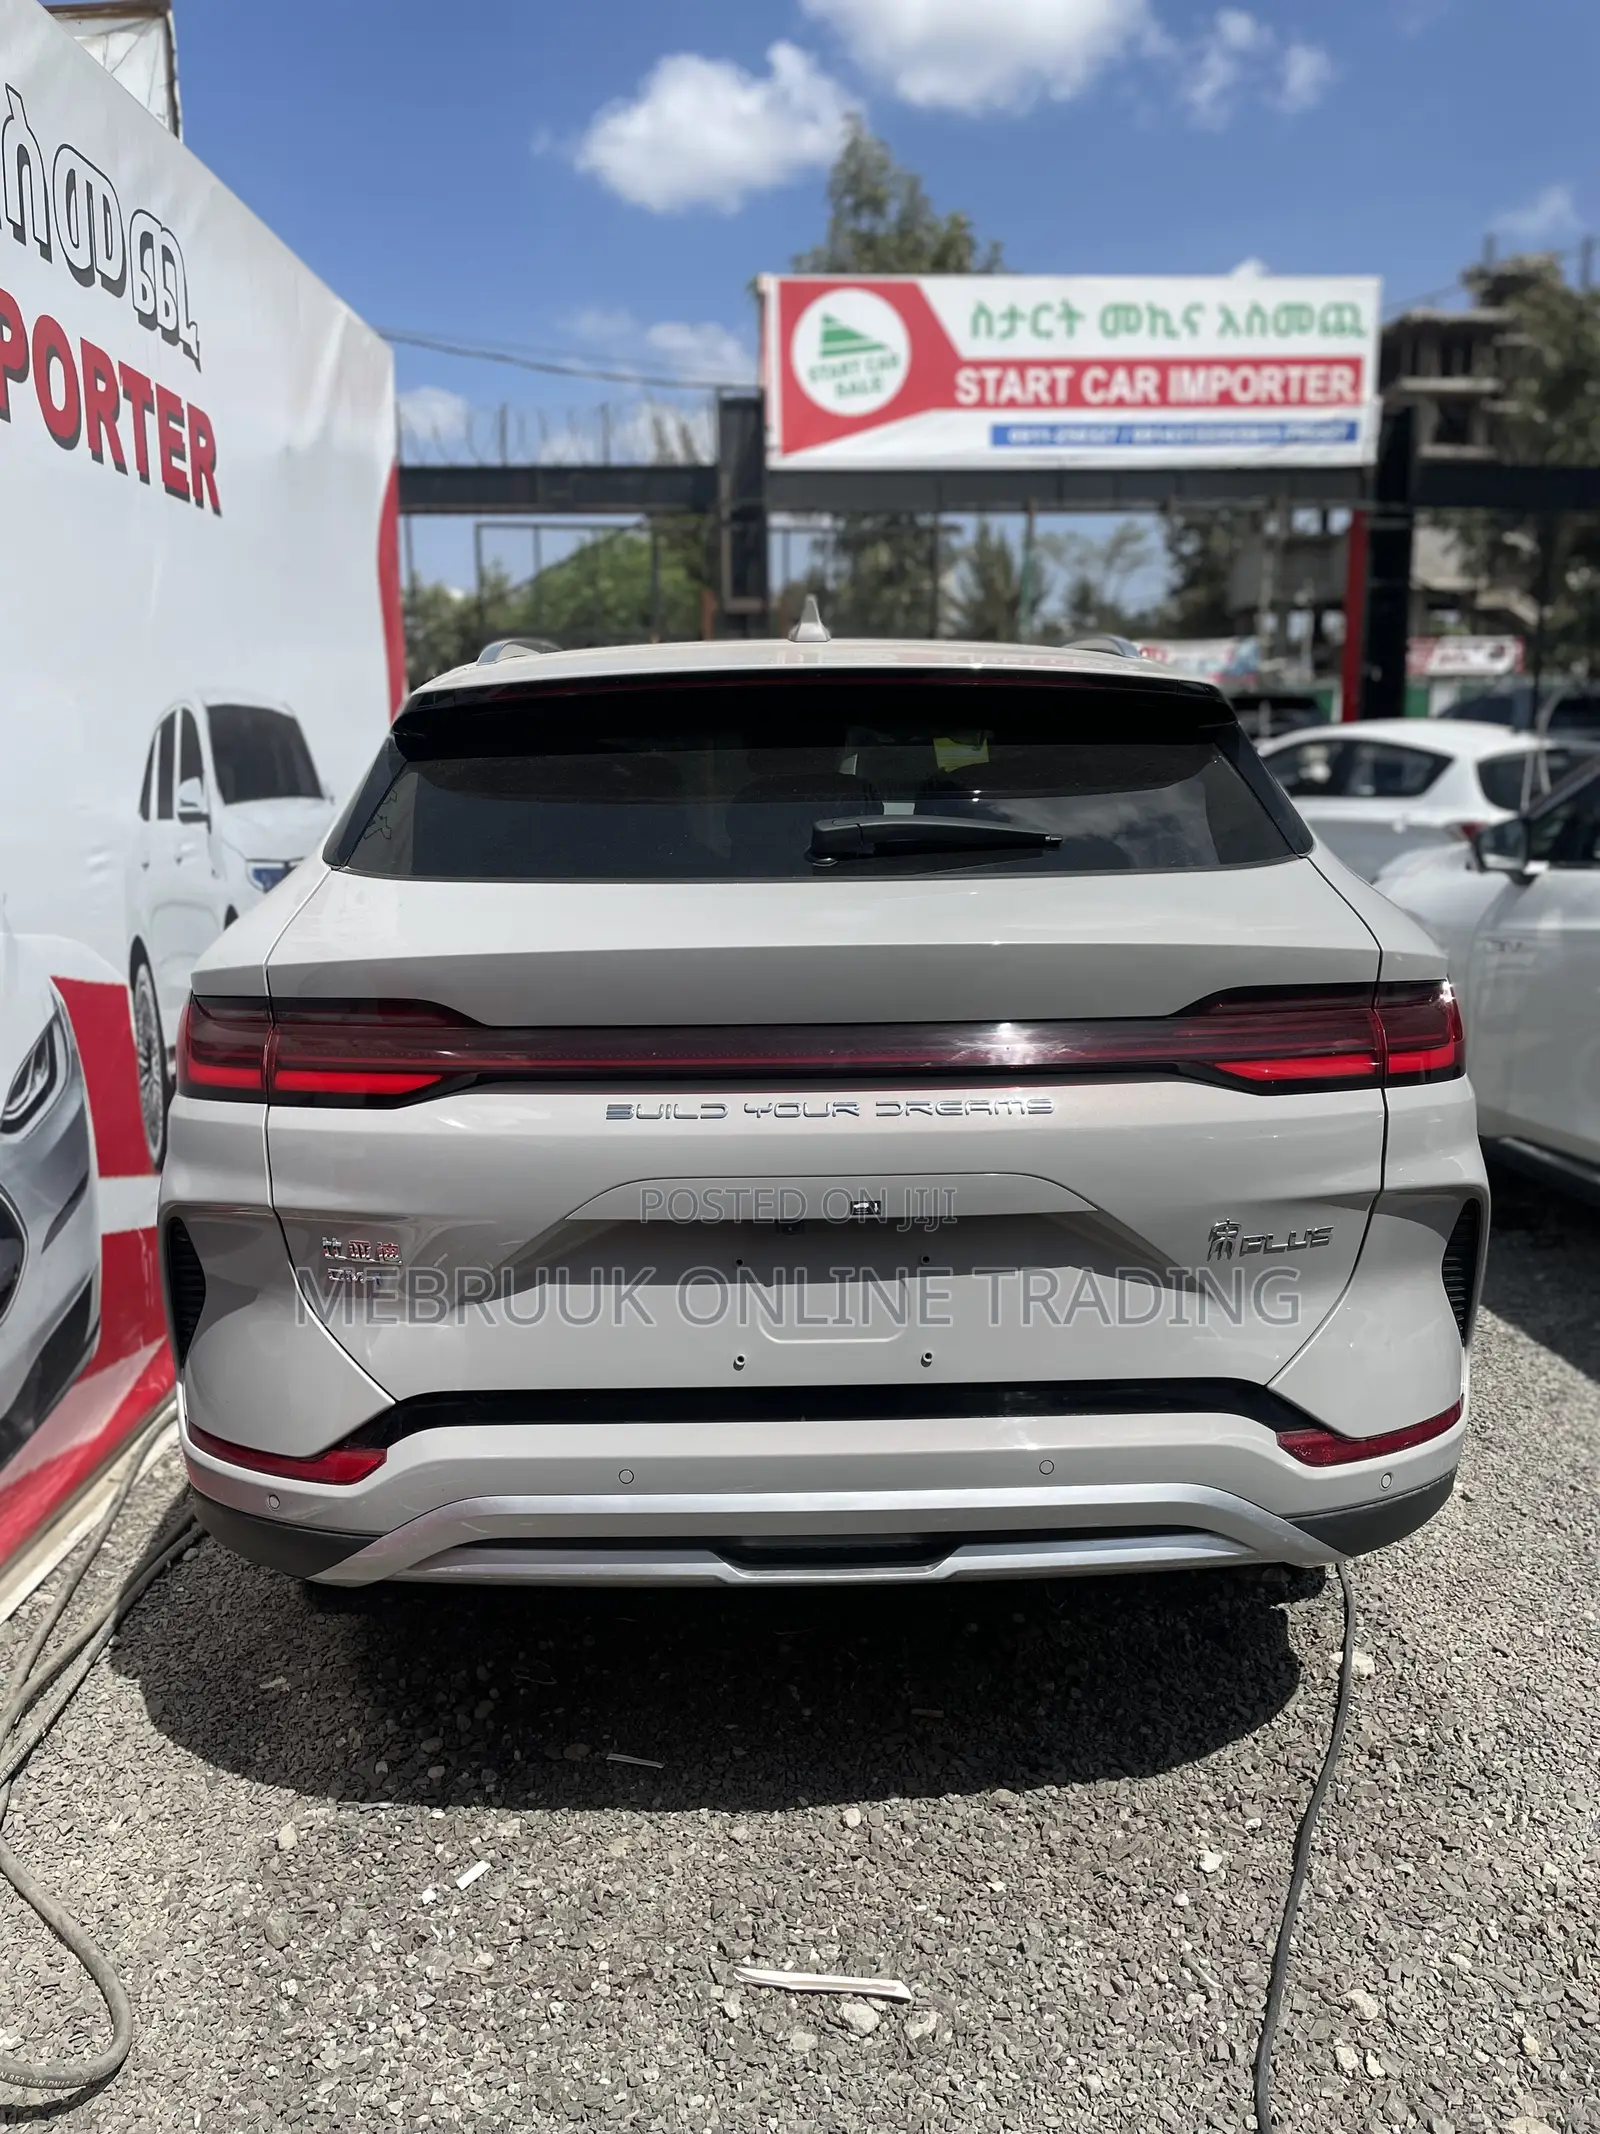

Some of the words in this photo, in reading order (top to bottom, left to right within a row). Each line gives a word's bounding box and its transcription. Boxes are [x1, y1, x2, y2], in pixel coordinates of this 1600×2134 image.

[0, 83, 201, 373] ስመጪ
[954, 366, 1074, 404] START
[1081, 366, 1160, 404] CAR
[1168, 365, 1357, 404] IMPORTER
[605, 1103, 729, 1121] BUILD
[743, 1101, 861, 1119] YOUR
[875, 1098, 1056, 1117] DREAMS
[1239, 1226, 1334, 1257] PLUS
